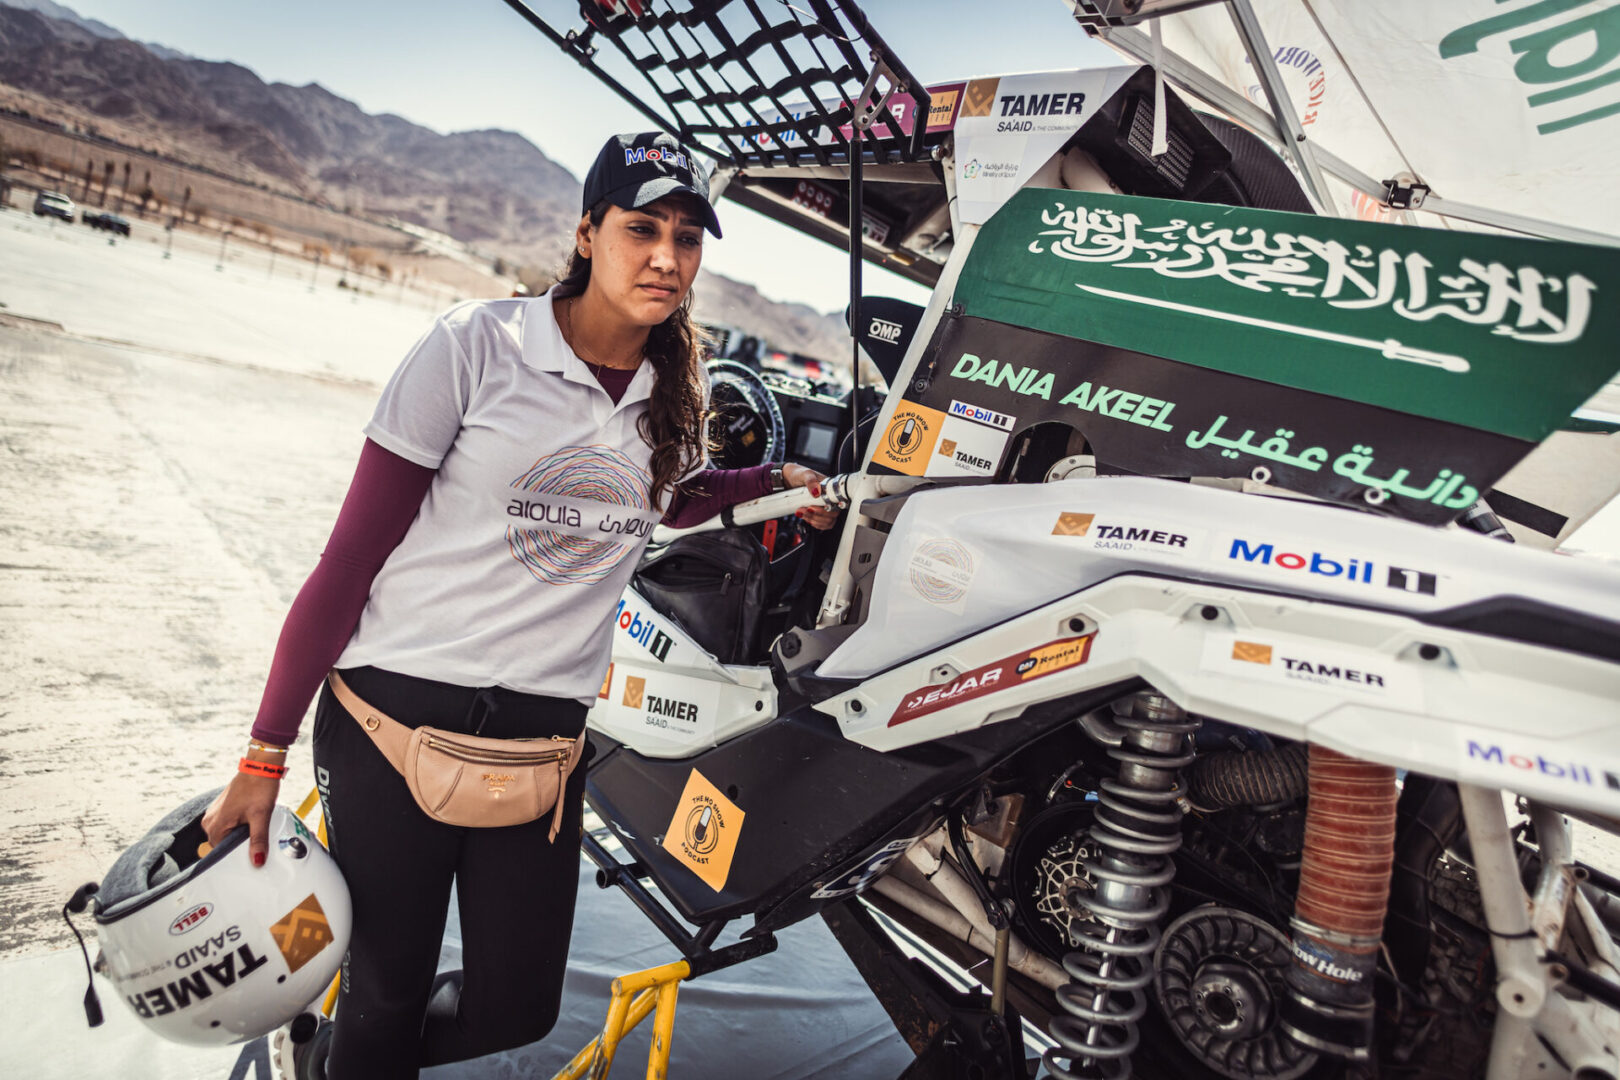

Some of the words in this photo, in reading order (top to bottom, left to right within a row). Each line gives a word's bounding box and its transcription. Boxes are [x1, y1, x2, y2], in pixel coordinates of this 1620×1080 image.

[999, 92, 1086, 117] TAMER
[624, 146, 689, 171] Mobil
[869, 321, 902, 341] OMP
[950, 353, 1056, 401] DANIA
[1058, 381, 1177, 433] AKEEL
[893, 412, 905, 421] THE
[916, 414, 929, 431] SHOW
[953, 402, 993, 422] Mobil
[885, 449, 912, 463] PODCAST
[1185, 415, 1329, 472] عقيل
[956, 451, 992, 471] TAMER
[507, 499, 582, 529] aloula
[1096, 525, 1188, 548] TAMER
[1229, 538, 1374, 585] Mobil
[1040, 645, 1080, 665] Rental
[1280, 657, 1384, 688] TAMER
[646, 695, 699, 723] TAMER
[1467, 739, 1592, 785] Mobil
[692, 795, 704, 804] THE
[704, 796, 714, 805] MO
[712, 804, 725, 829] SHOW
[681, 841, 710, 865] PODCAST
[174, 906, 209, 932] BELL
[127, 943, 268, 1018] TAMER
[1317, 960, 1363, 982] Hole
